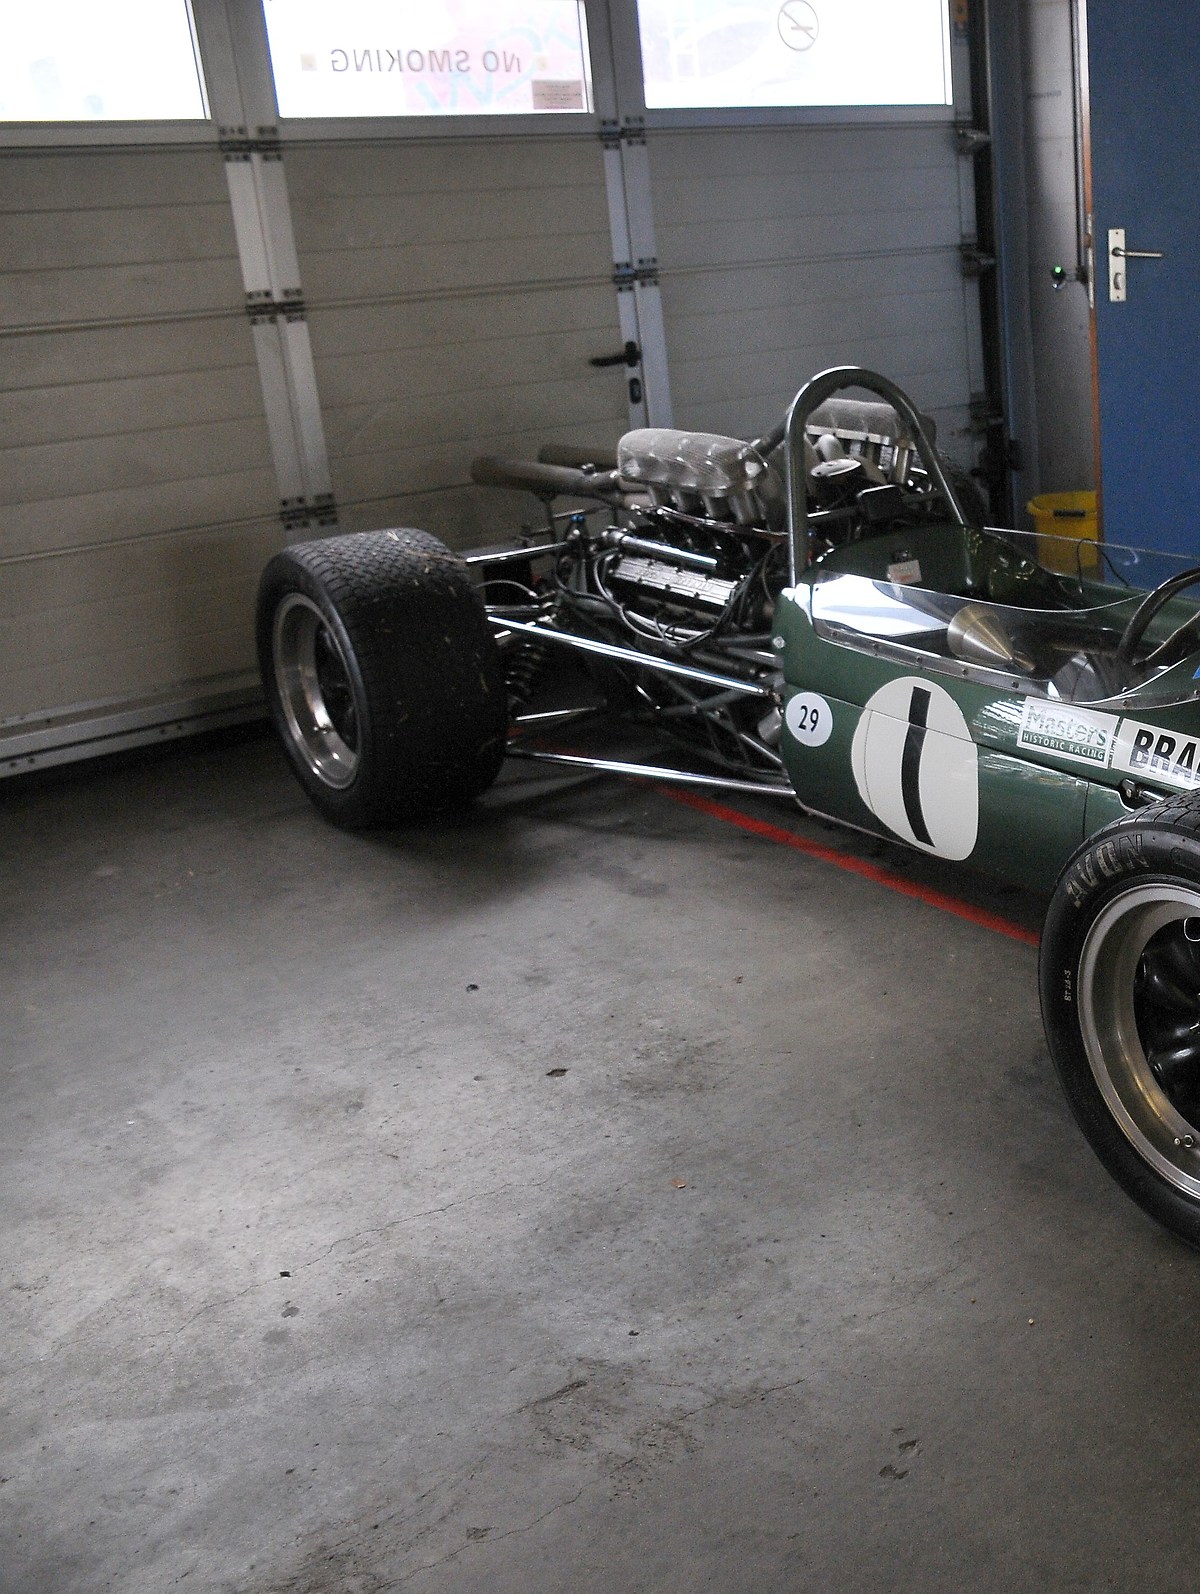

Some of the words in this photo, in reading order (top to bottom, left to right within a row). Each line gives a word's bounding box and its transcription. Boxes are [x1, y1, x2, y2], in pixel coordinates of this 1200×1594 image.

[798, 705, 819, 732] 29
[1026, 704, 1108, 746] Masters
[902, 686, 935, 847] 1
[1023, 732, 1065, 749] HISTORIC
[1068, 743, 1104, 760] RACING
[1065, 834, 1149, 908] AVON
